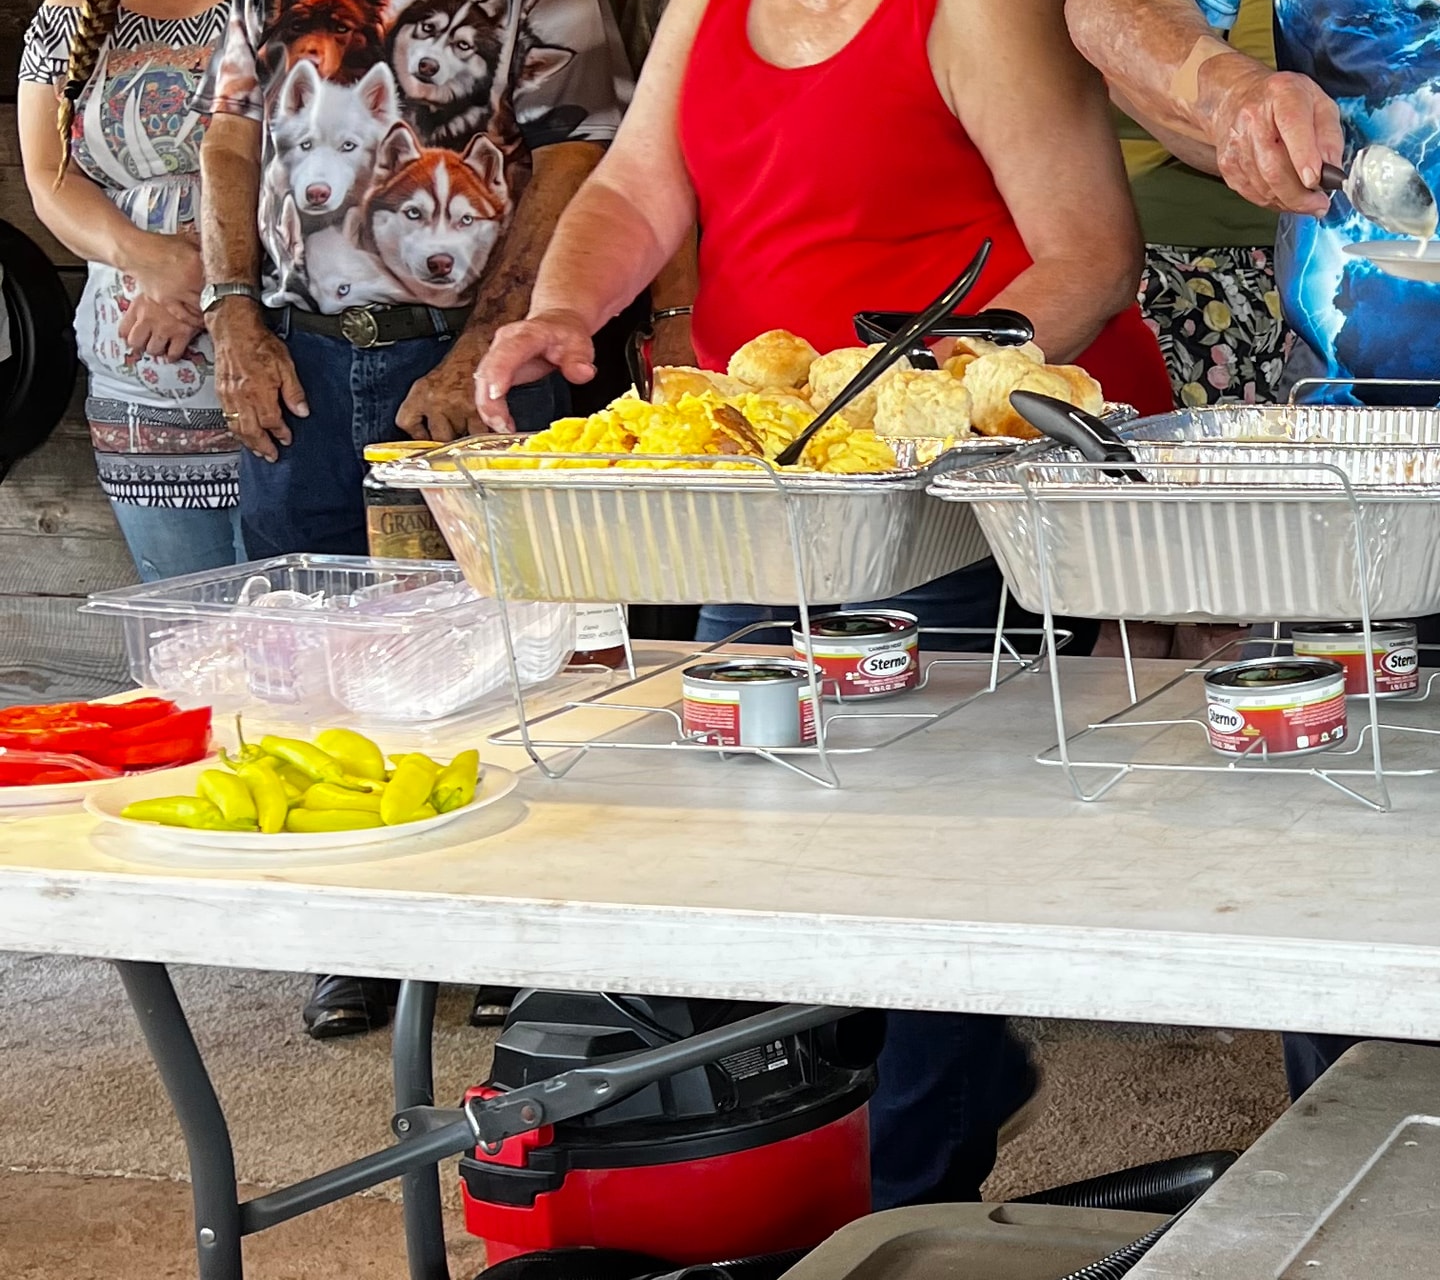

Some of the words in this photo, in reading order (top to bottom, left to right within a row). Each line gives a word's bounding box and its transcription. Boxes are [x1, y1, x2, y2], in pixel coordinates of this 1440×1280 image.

[869, 656, 907, 671] Sterno
[1390, 655, 1416, 668] Stern
[1209, 708, 1237, 727] Sterno
